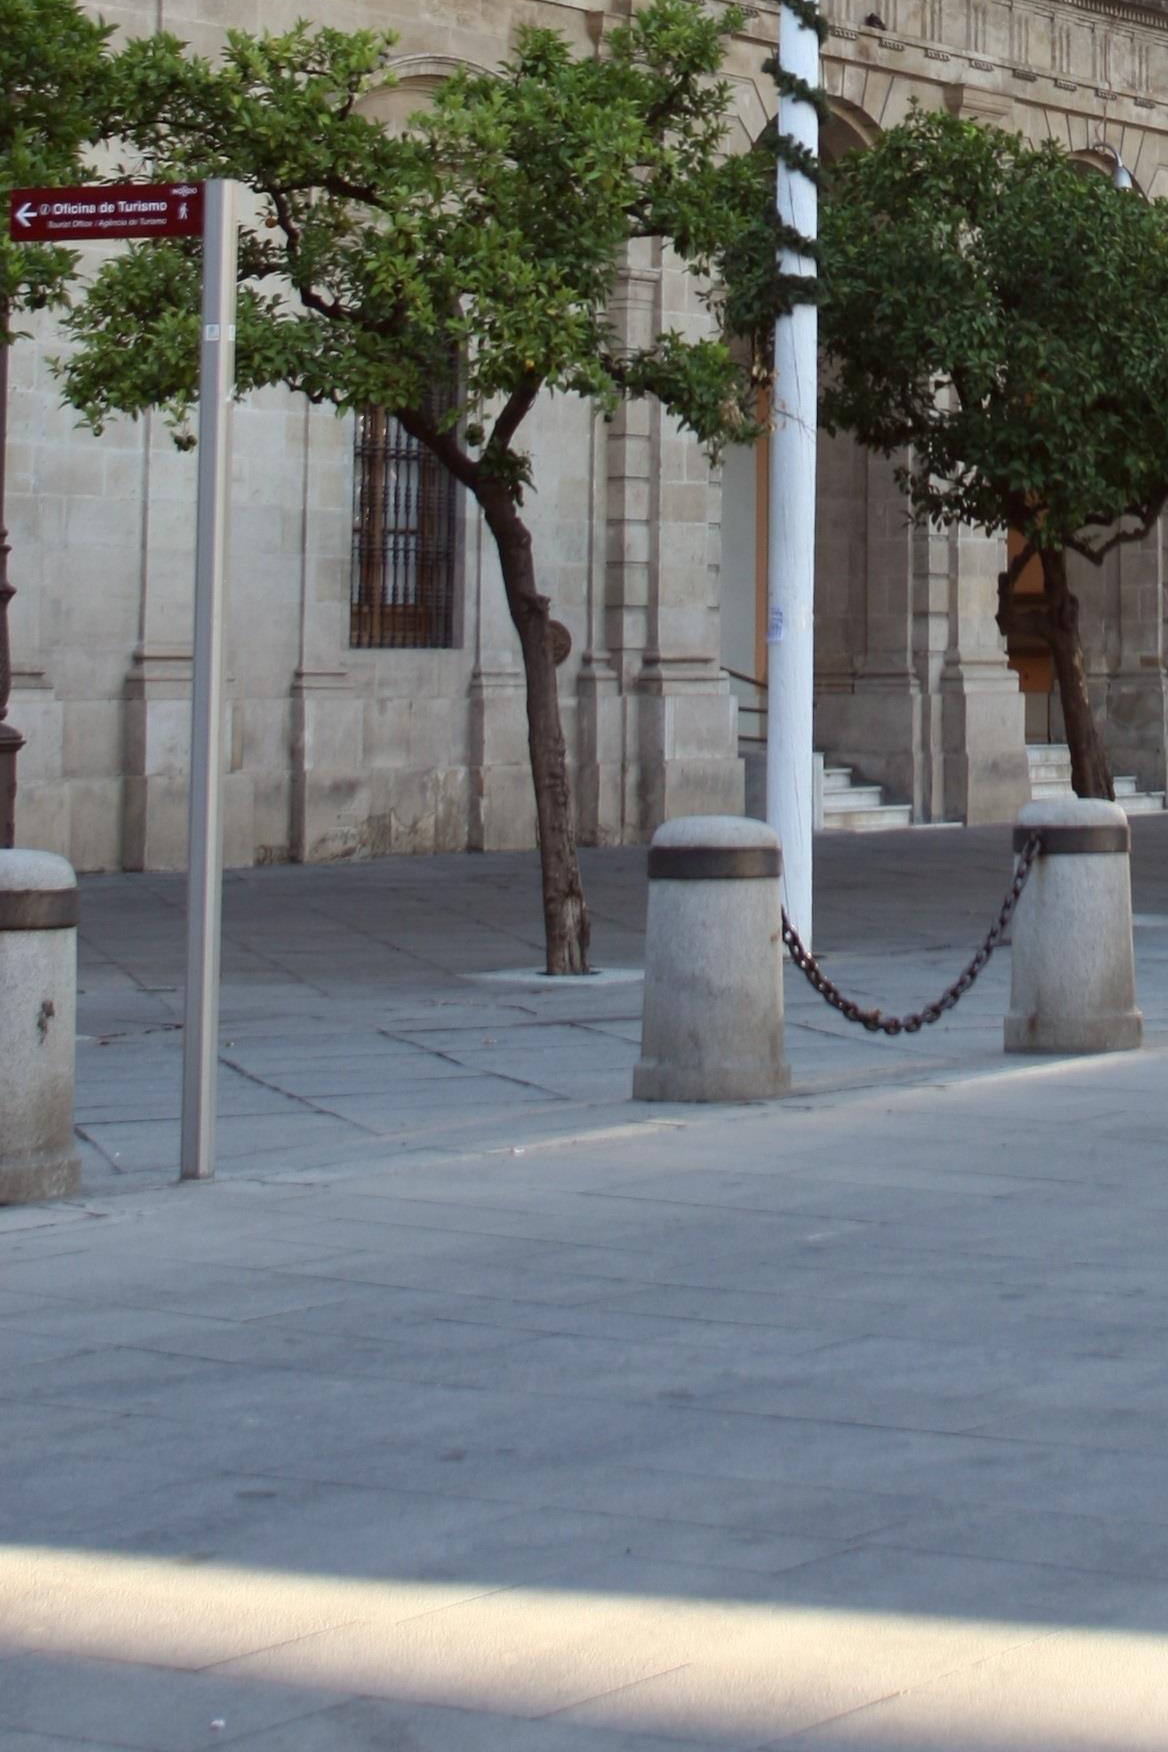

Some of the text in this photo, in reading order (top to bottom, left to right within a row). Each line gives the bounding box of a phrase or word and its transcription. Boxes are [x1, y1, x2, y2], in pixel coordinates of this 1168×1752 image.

[53, 200, 168, 215] Oficina de Turismo
